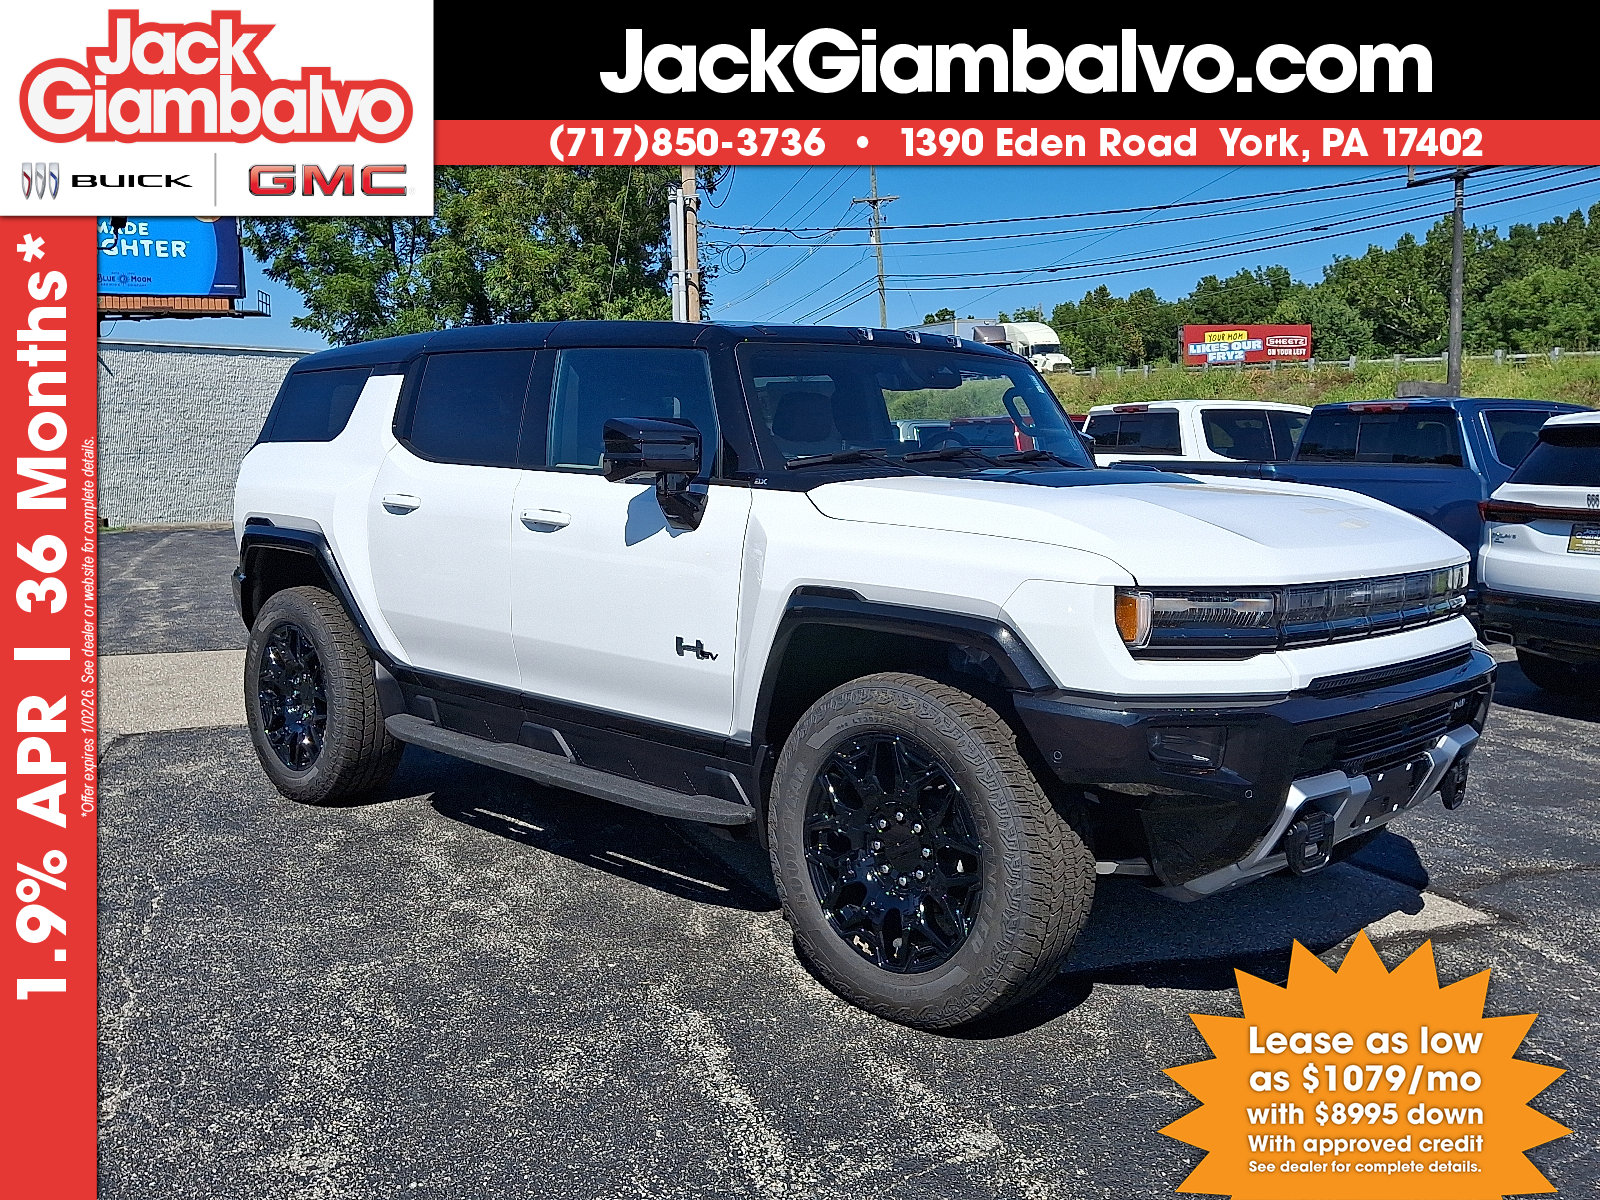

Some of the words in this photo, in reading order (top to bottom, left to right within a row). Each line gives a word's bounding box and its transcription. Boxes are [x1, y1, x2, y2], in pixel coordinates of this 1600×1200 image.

[1208, 334, 1225, 342] YOUR
[1228, 333, 1243, 341] MOM
[1189, 342, 1230, 354] LIKES
[1231, 340, 1262, 351] OUR
[1267, 348, 1276, 356] ON
[1276, 348, 1292, 356] YOUR
[1292, 348, 1307, 356] LEFT
[1208, 350, 1245, 361] FRYZ
